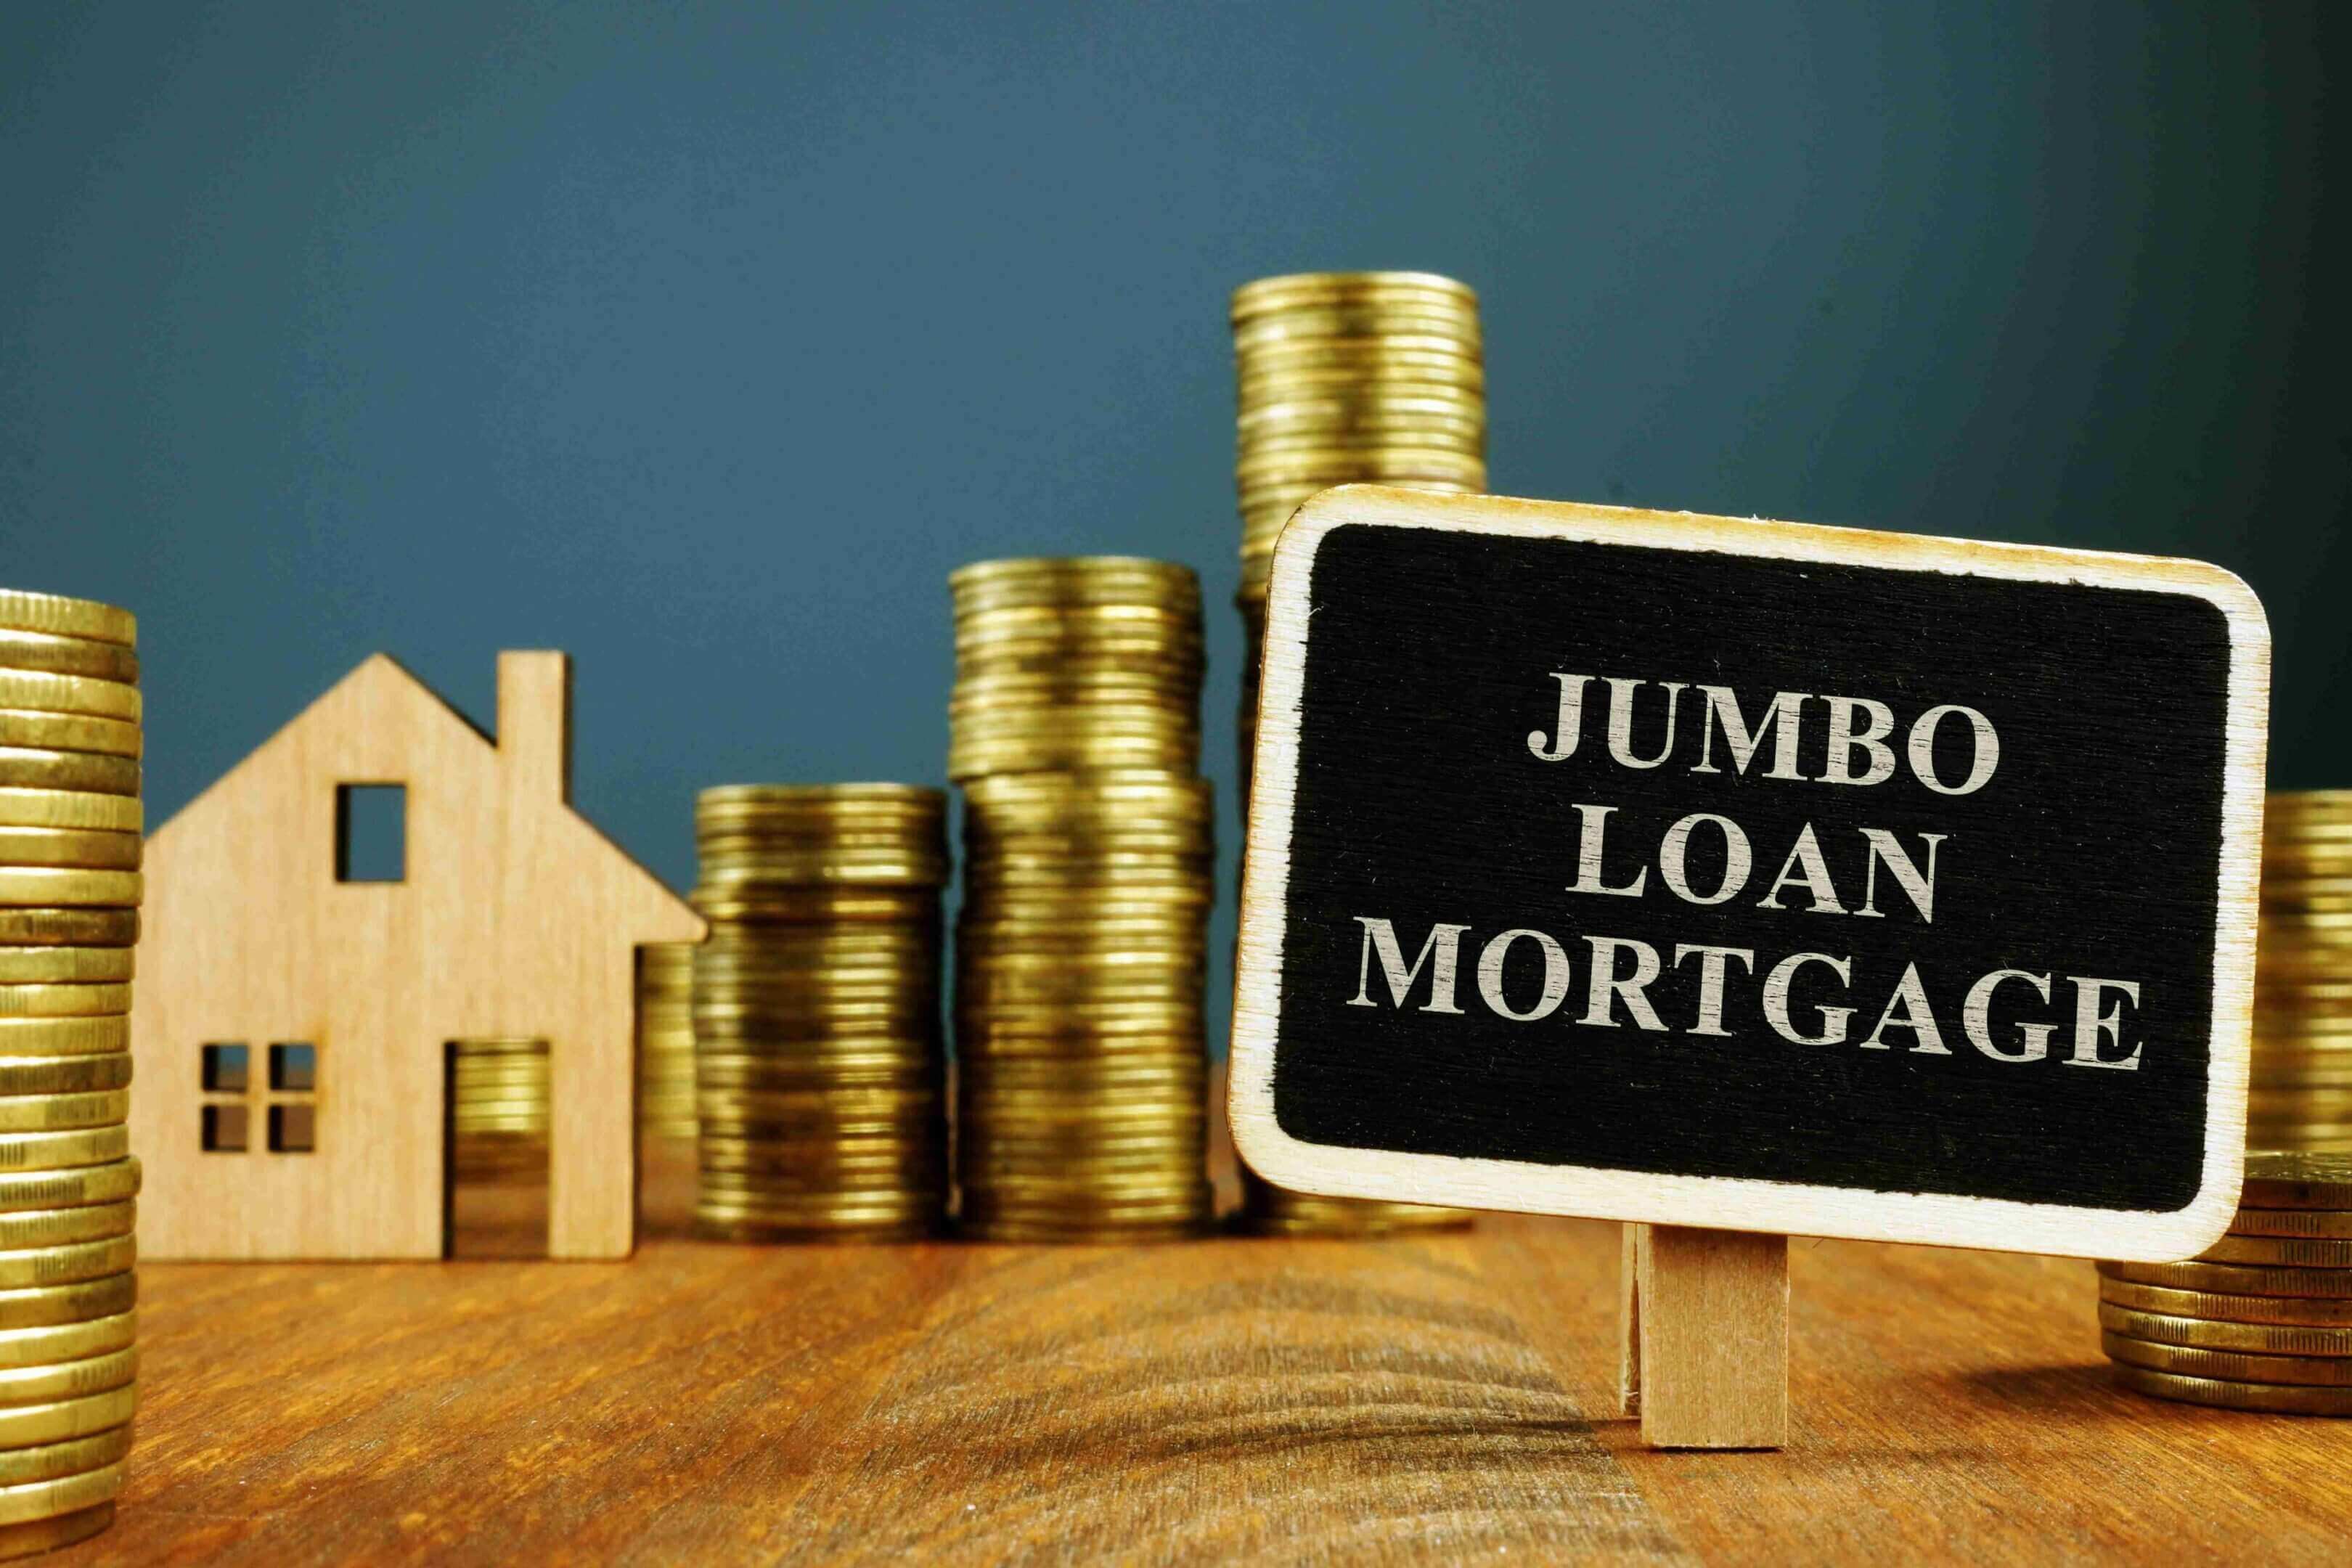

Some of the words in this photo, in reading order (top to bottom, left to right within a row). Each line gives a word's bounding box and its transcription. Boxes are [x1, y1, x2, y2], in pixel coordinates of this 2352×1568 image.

[1527, 671, 2001, 796] JUMBO
[1564, 803, 1949, 925] LOAN
[1345, 915, 2142, 1071] MORTGAGE
